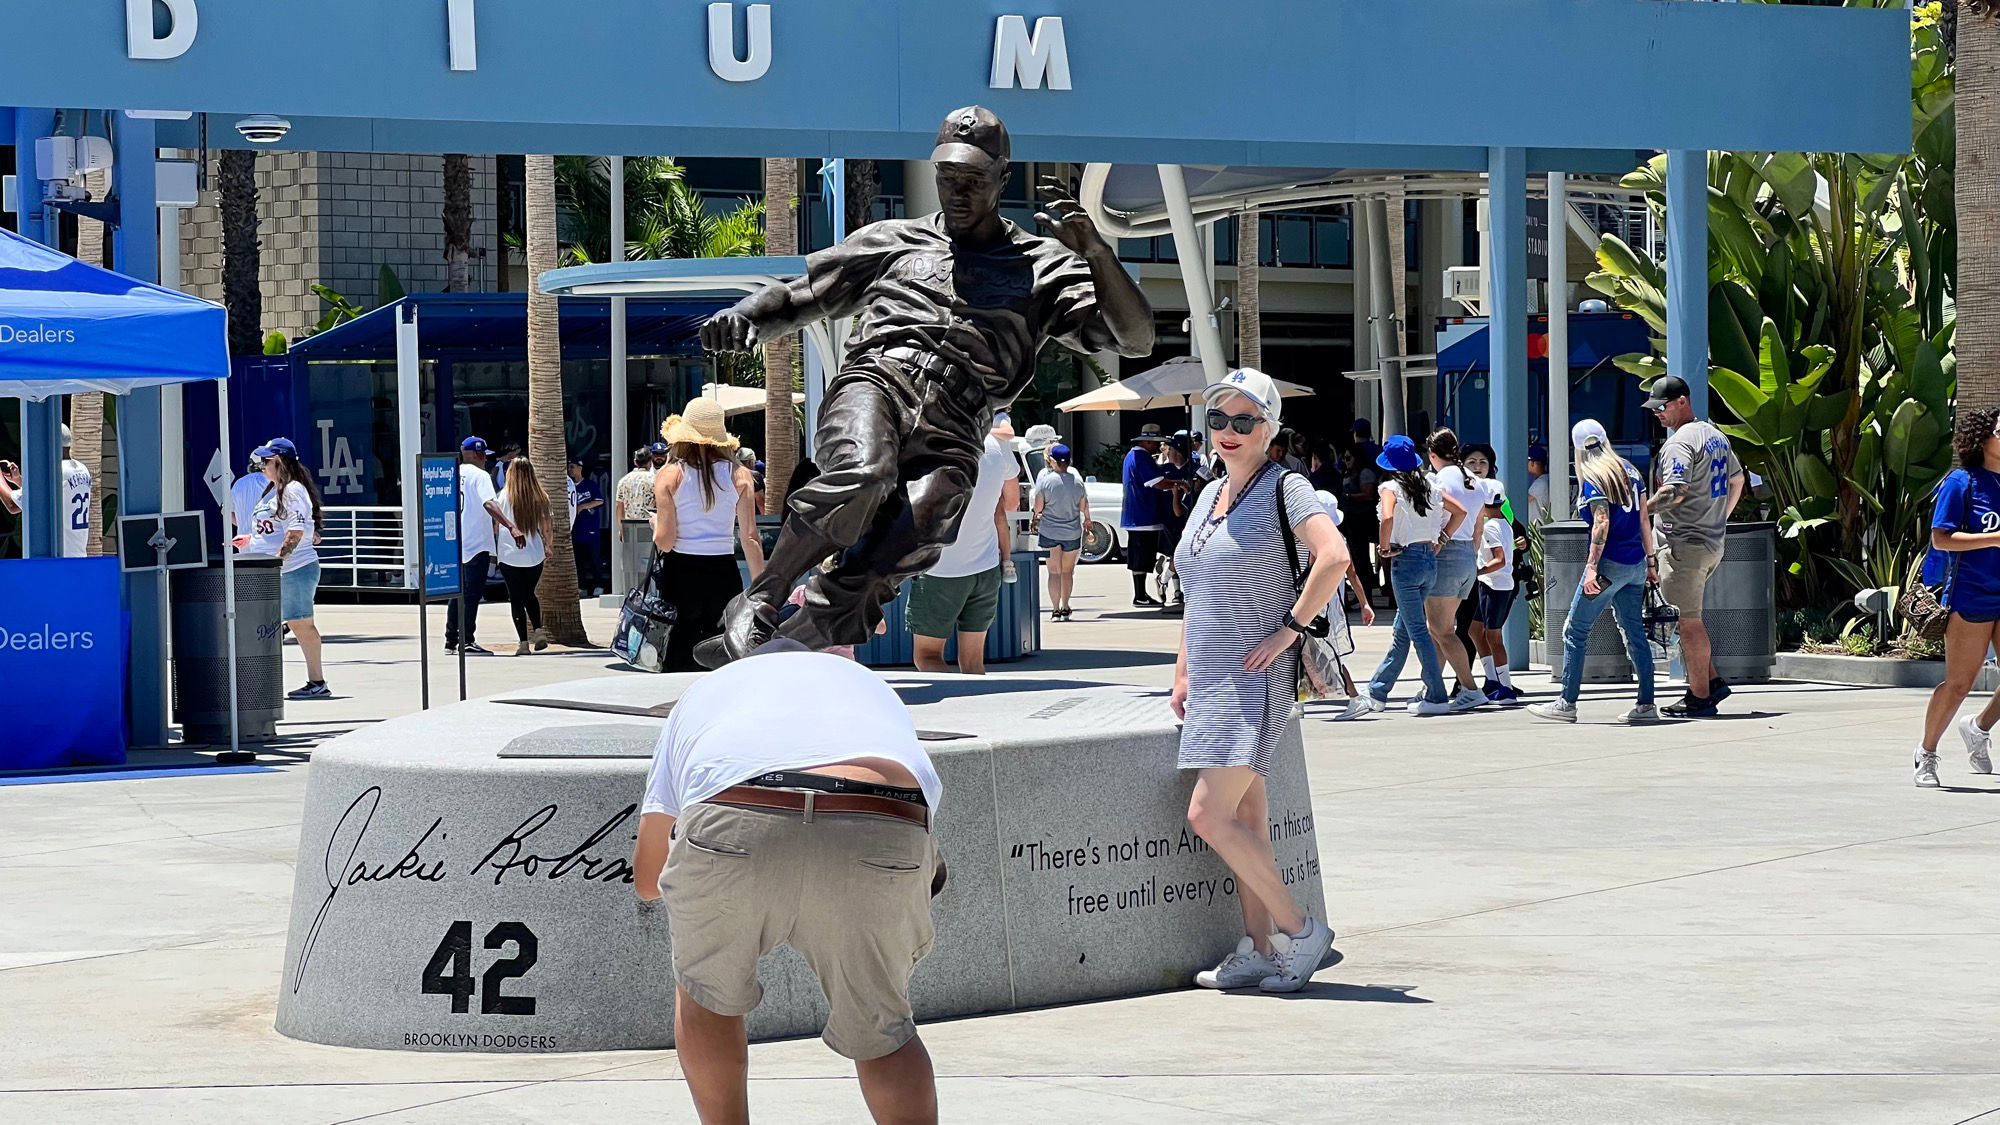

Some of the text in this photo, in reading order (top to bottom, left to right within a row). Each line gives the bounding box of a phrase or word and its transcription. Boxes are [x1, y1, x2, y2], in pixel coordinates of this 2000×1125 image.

[1527, 237, 1549, 257] STADIU
[0, 323, 75, 343] Dealers
[317, 419, 364, 495] LA
[422, 467, 439, 481] Helpful
[1710, 456, 1728, 499] 22
[425, 483, 452, 499] Sign me up!
[257, 519, 275, 535] 50
[761, 773, 784, 782] ES
[873, 788, 918, 801] HANES
[1108, 836, 1139, 862] not
[1146, 837, 1169, 858] an
[1269, 818, 1280, 841] in
[1284, 809, 1302, 839] this
[294, 785, 447, 994] Jackie
[1068, 885, 1109, 915] free
[1117, 875, 1156, 909] until
[1163, 879, 1217, 906] every
[1282, 866, 1295, 886] us
[1297, 857, 1305, 881] is
[421, 920, 539, 1016] 42
[404, 1032, 556, 1049] BROOKLYN DODGERS
